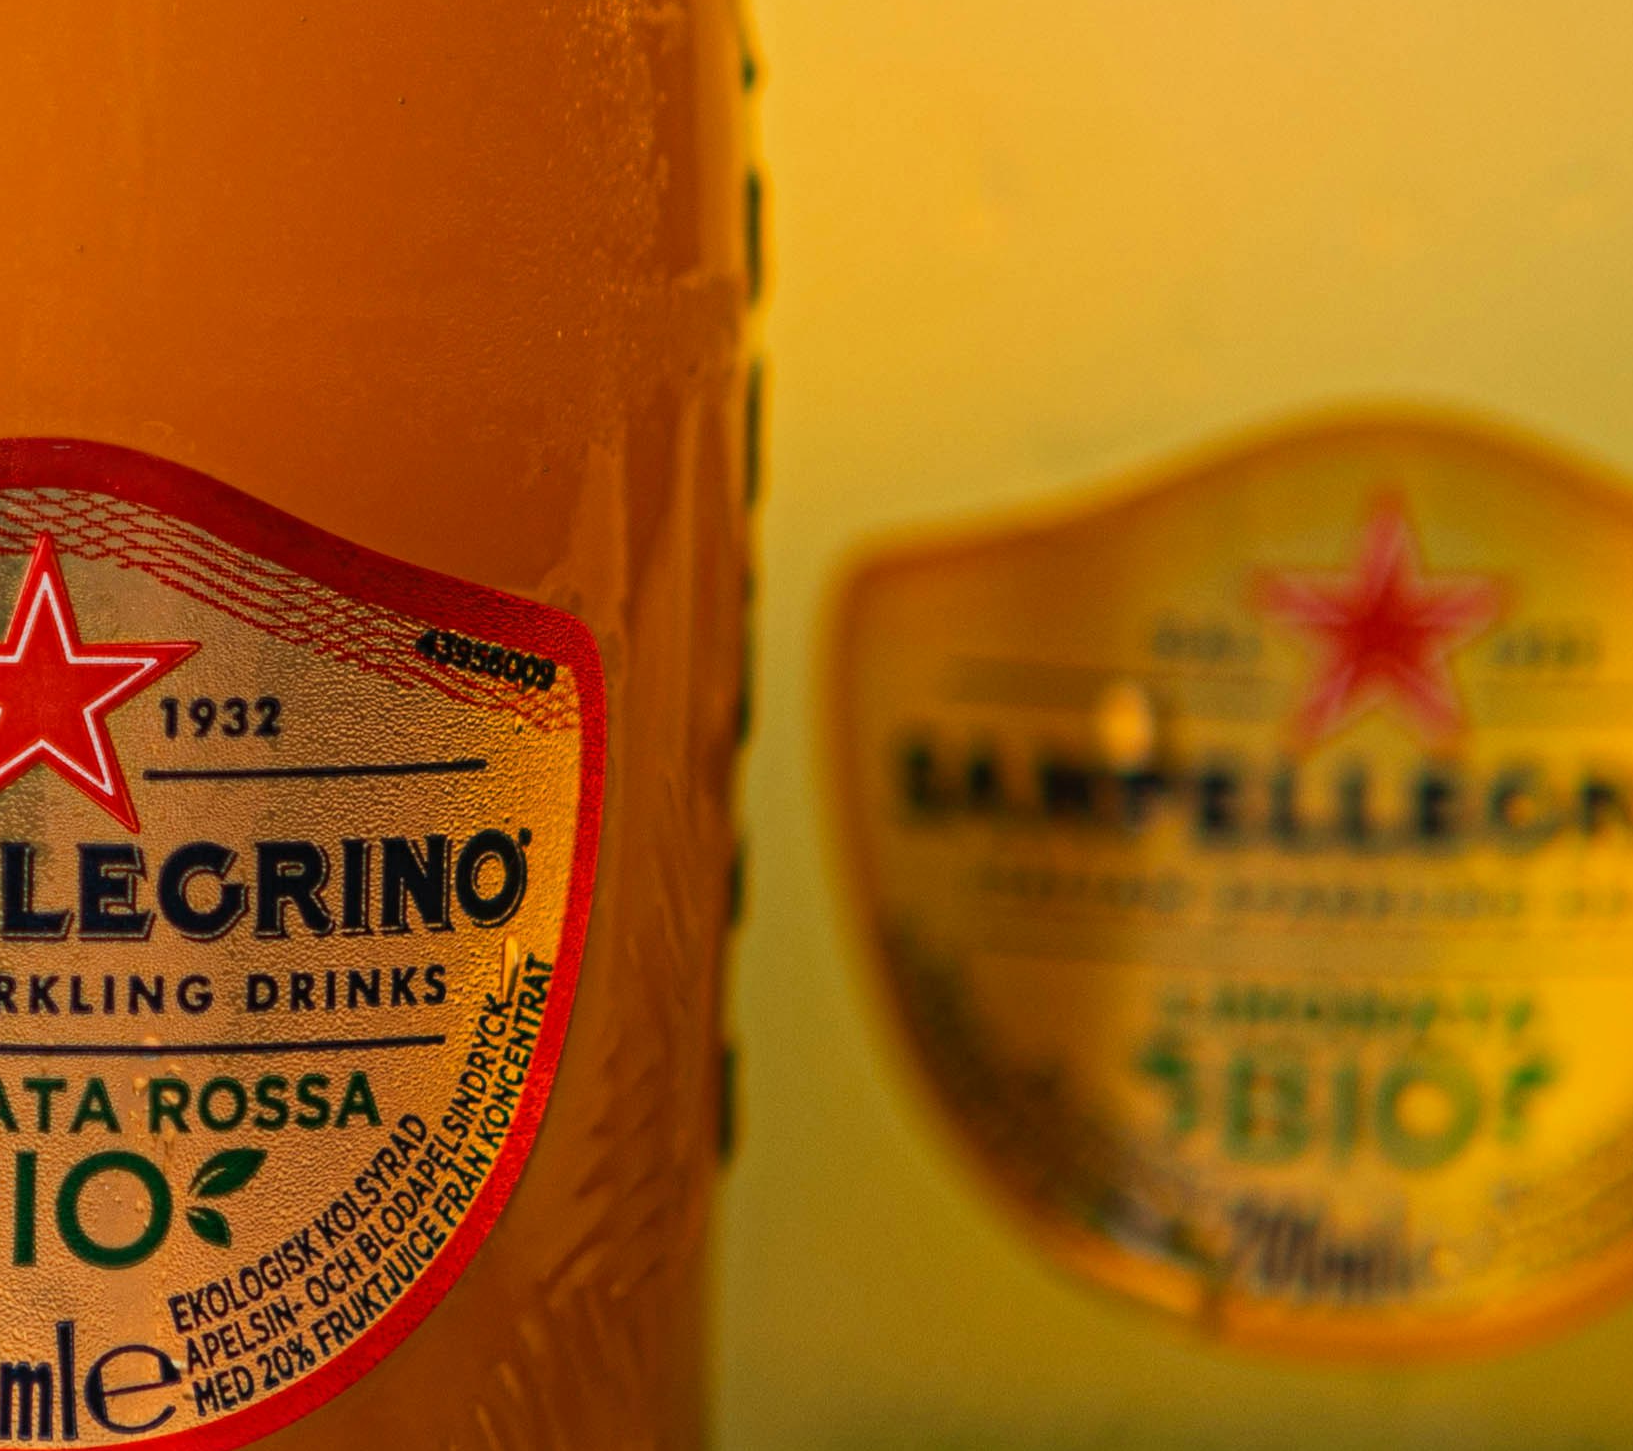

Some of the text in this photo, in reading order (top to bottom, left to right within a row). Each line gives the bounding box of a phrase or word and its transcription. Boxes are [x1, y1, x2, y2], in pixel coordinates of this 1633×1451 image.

[161, 696, 282, 739] 1932
[246, 964, 448, 1013] DRINKS
[148, 1070, 383, 1134] ROSSA
[167, 1112, 428, 1335] EKOLOGISK KOLSYRAD
[186, 992, 514, 1376] APELSIN- OCH BLODAPELSINDRYCK
[191, 1363, 255, 1417] MED
[256, 1332, 317, 1391] 20%
[310, 1214, 448, 1358] FRUKTJUICE
[474, 951, 554, 1150] KONCENTRAT
